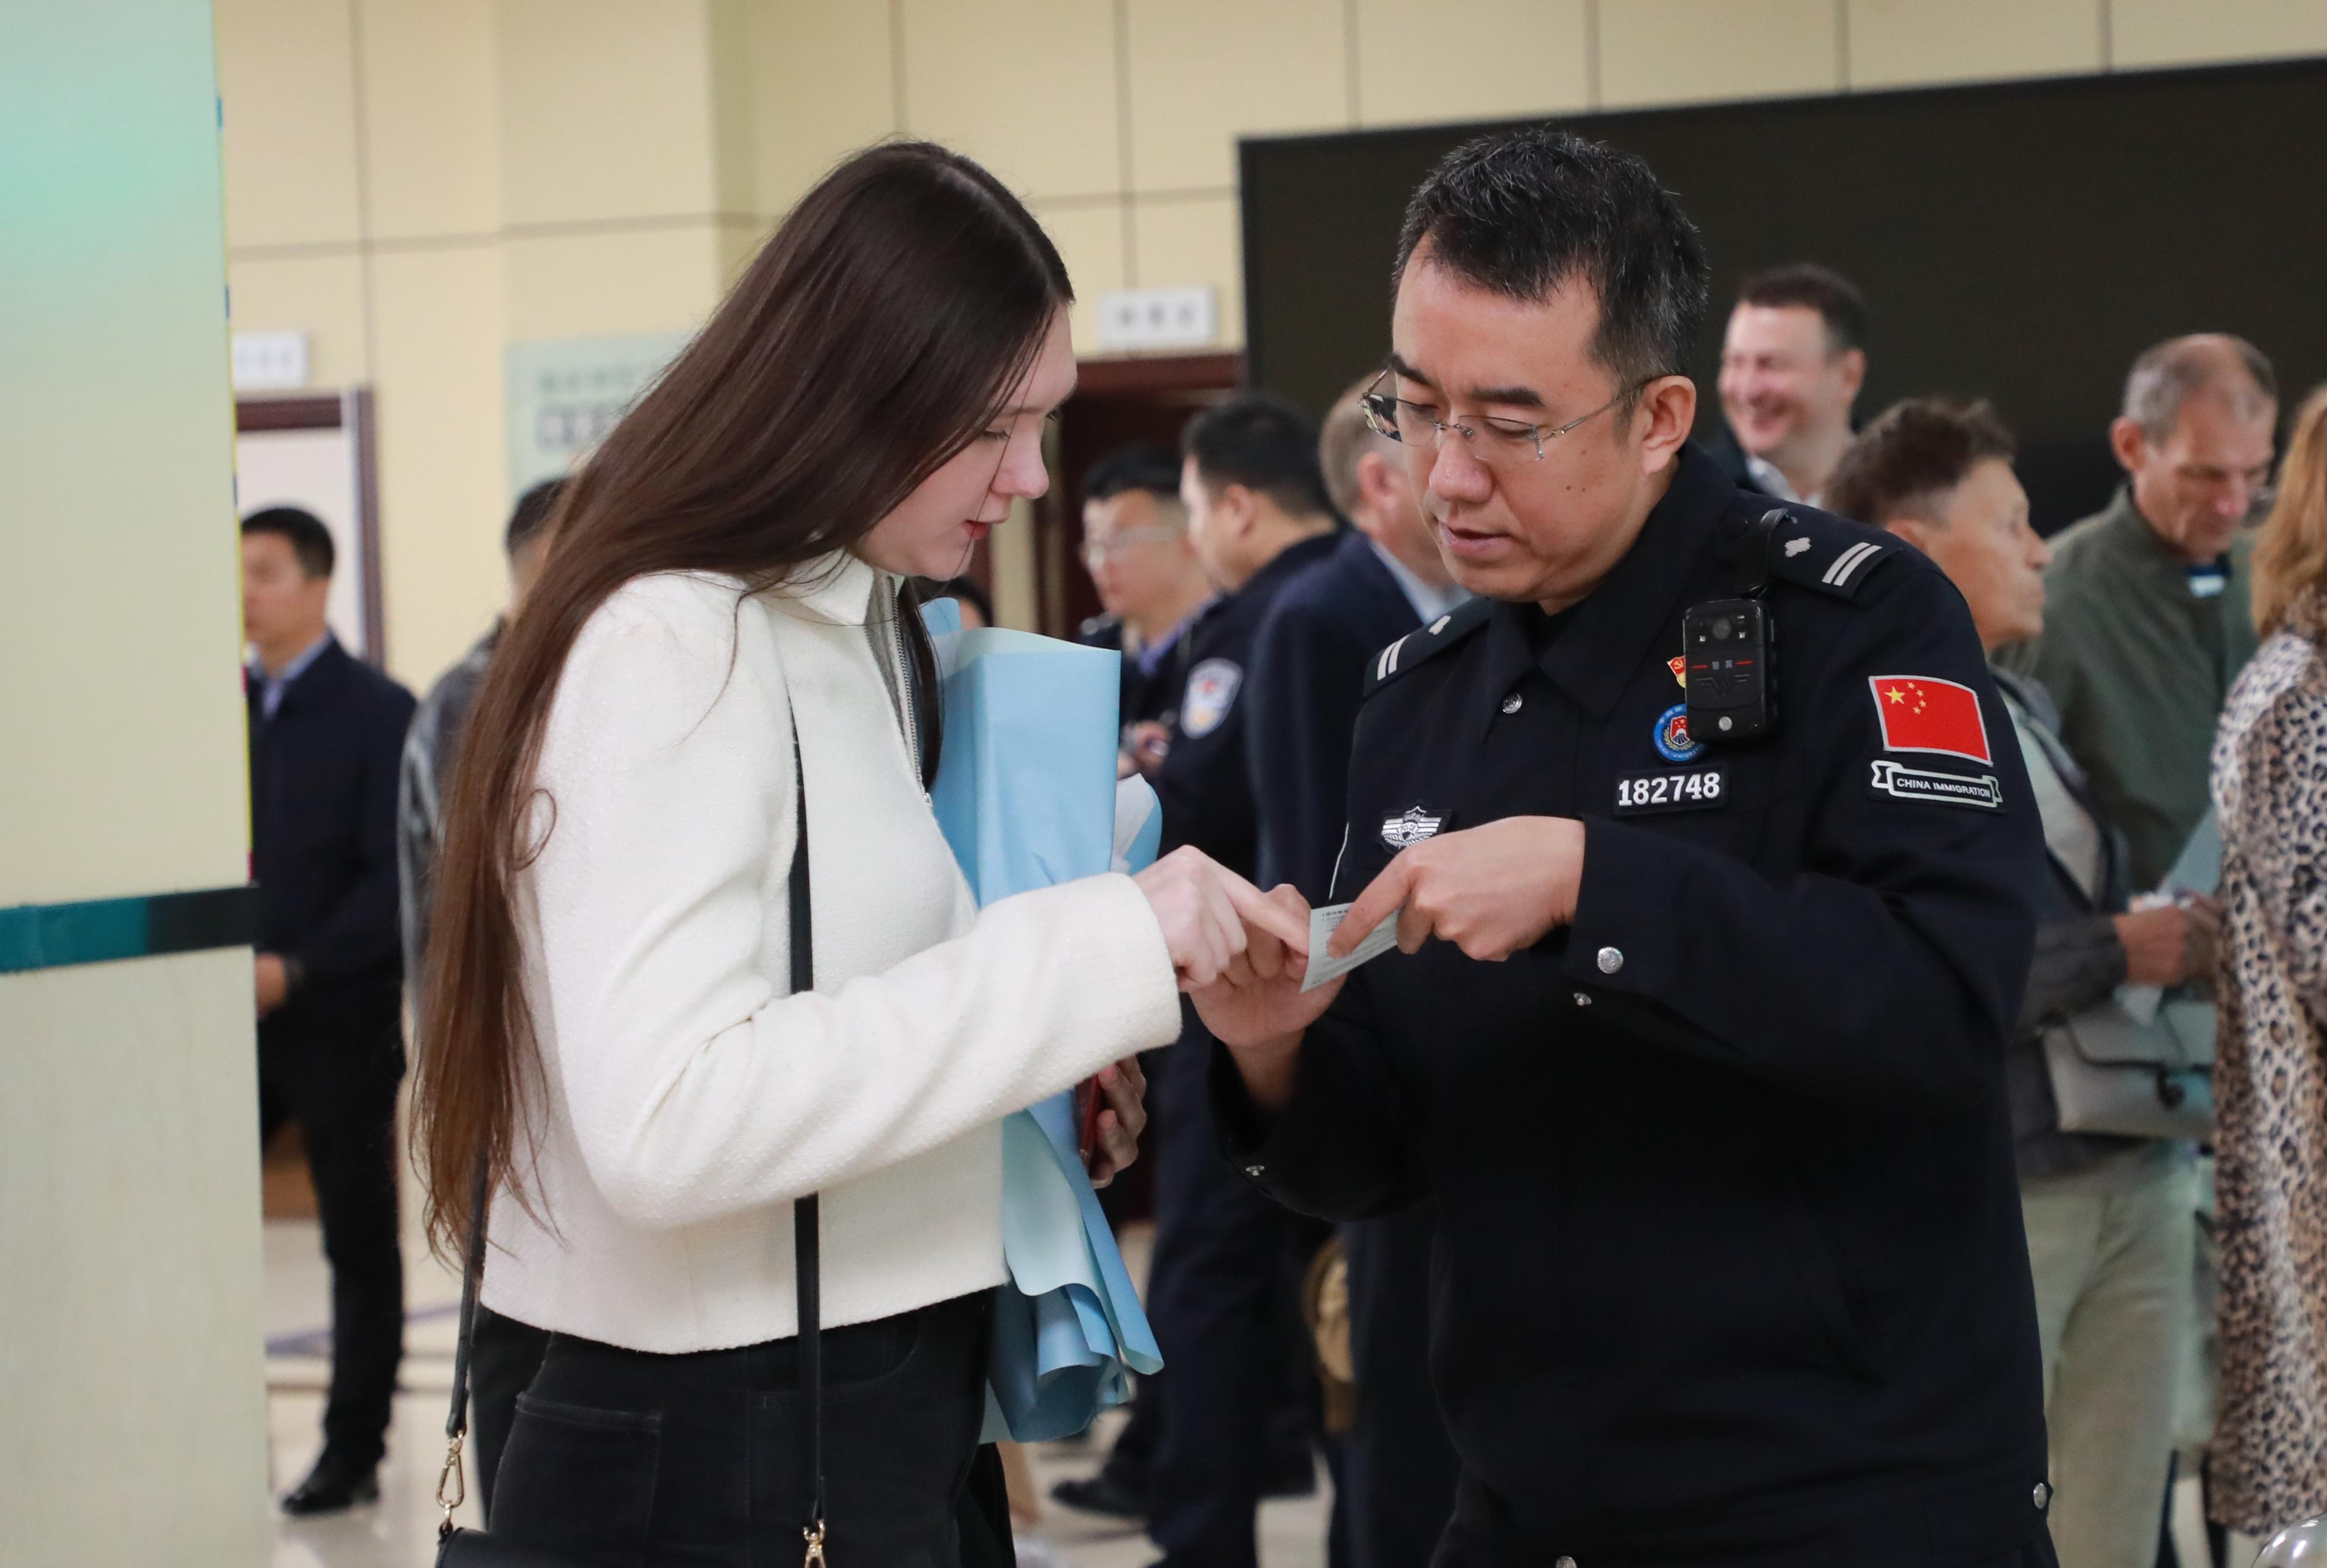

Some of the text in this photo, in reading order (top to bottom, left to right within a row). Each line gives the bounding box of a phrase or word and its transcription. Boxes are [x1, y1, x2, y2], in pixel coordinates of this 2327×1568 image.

[1619, 772, 1720, 806] 182748
[1896, 777, 1991, 798] CHINA IMMIGRATION
